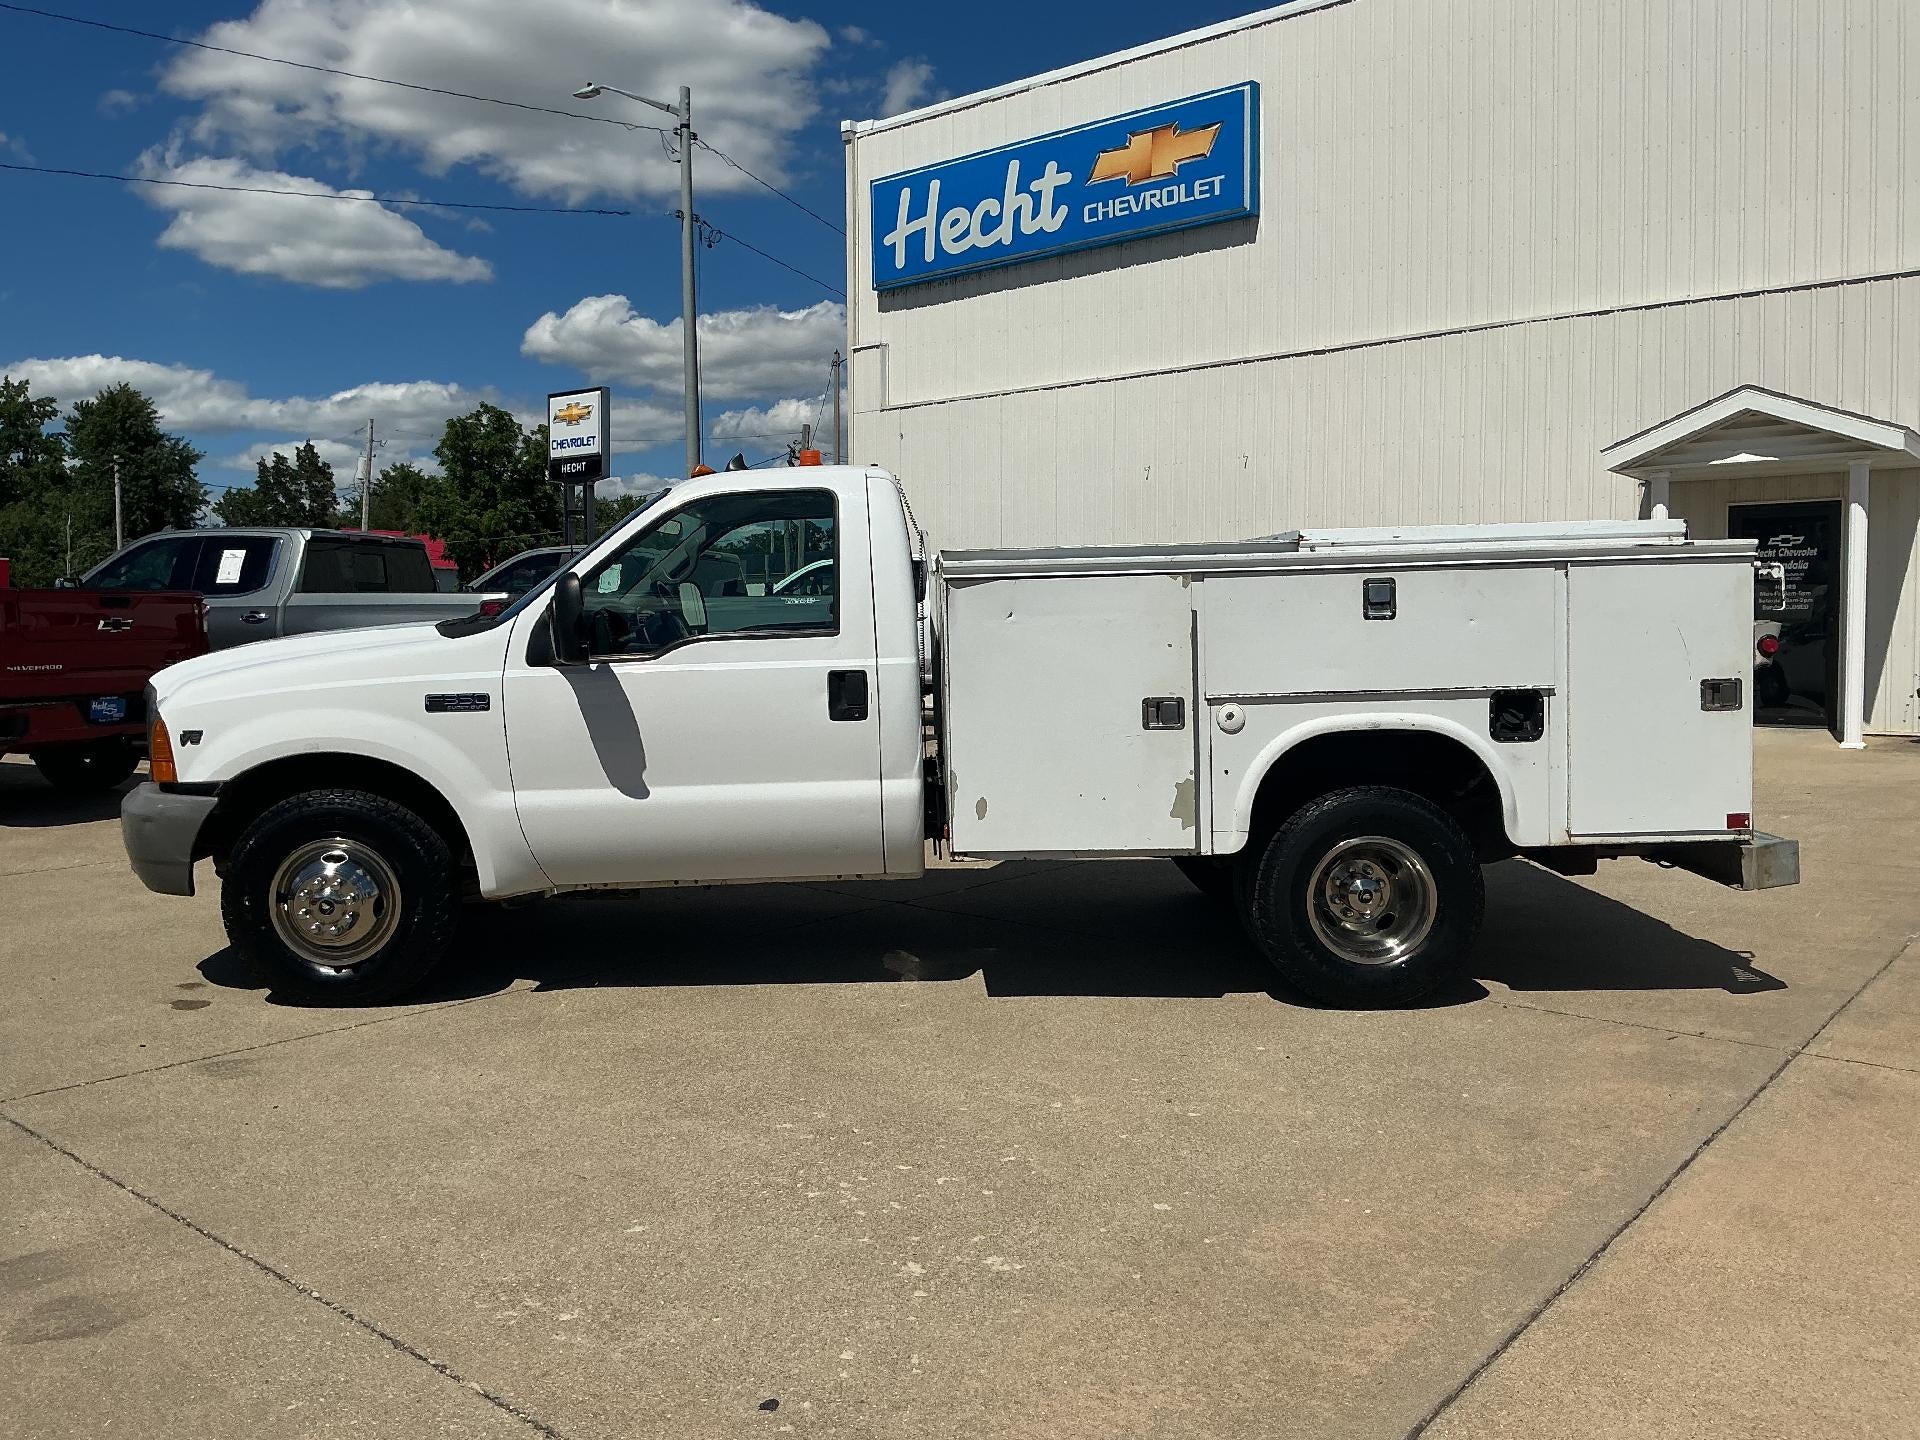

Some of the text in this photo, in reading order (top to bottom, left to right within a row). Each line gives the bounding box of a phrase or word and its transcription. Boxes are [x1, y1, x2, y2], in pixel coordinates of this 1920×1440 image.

[884, 159, 1226, 269] Hecht CHEVROLET
[551, 435, 597, 450] CHEVROLET
[561, 462, 587, 473] HECHT
[1778, 546, 1818, 558] Chevrolet
